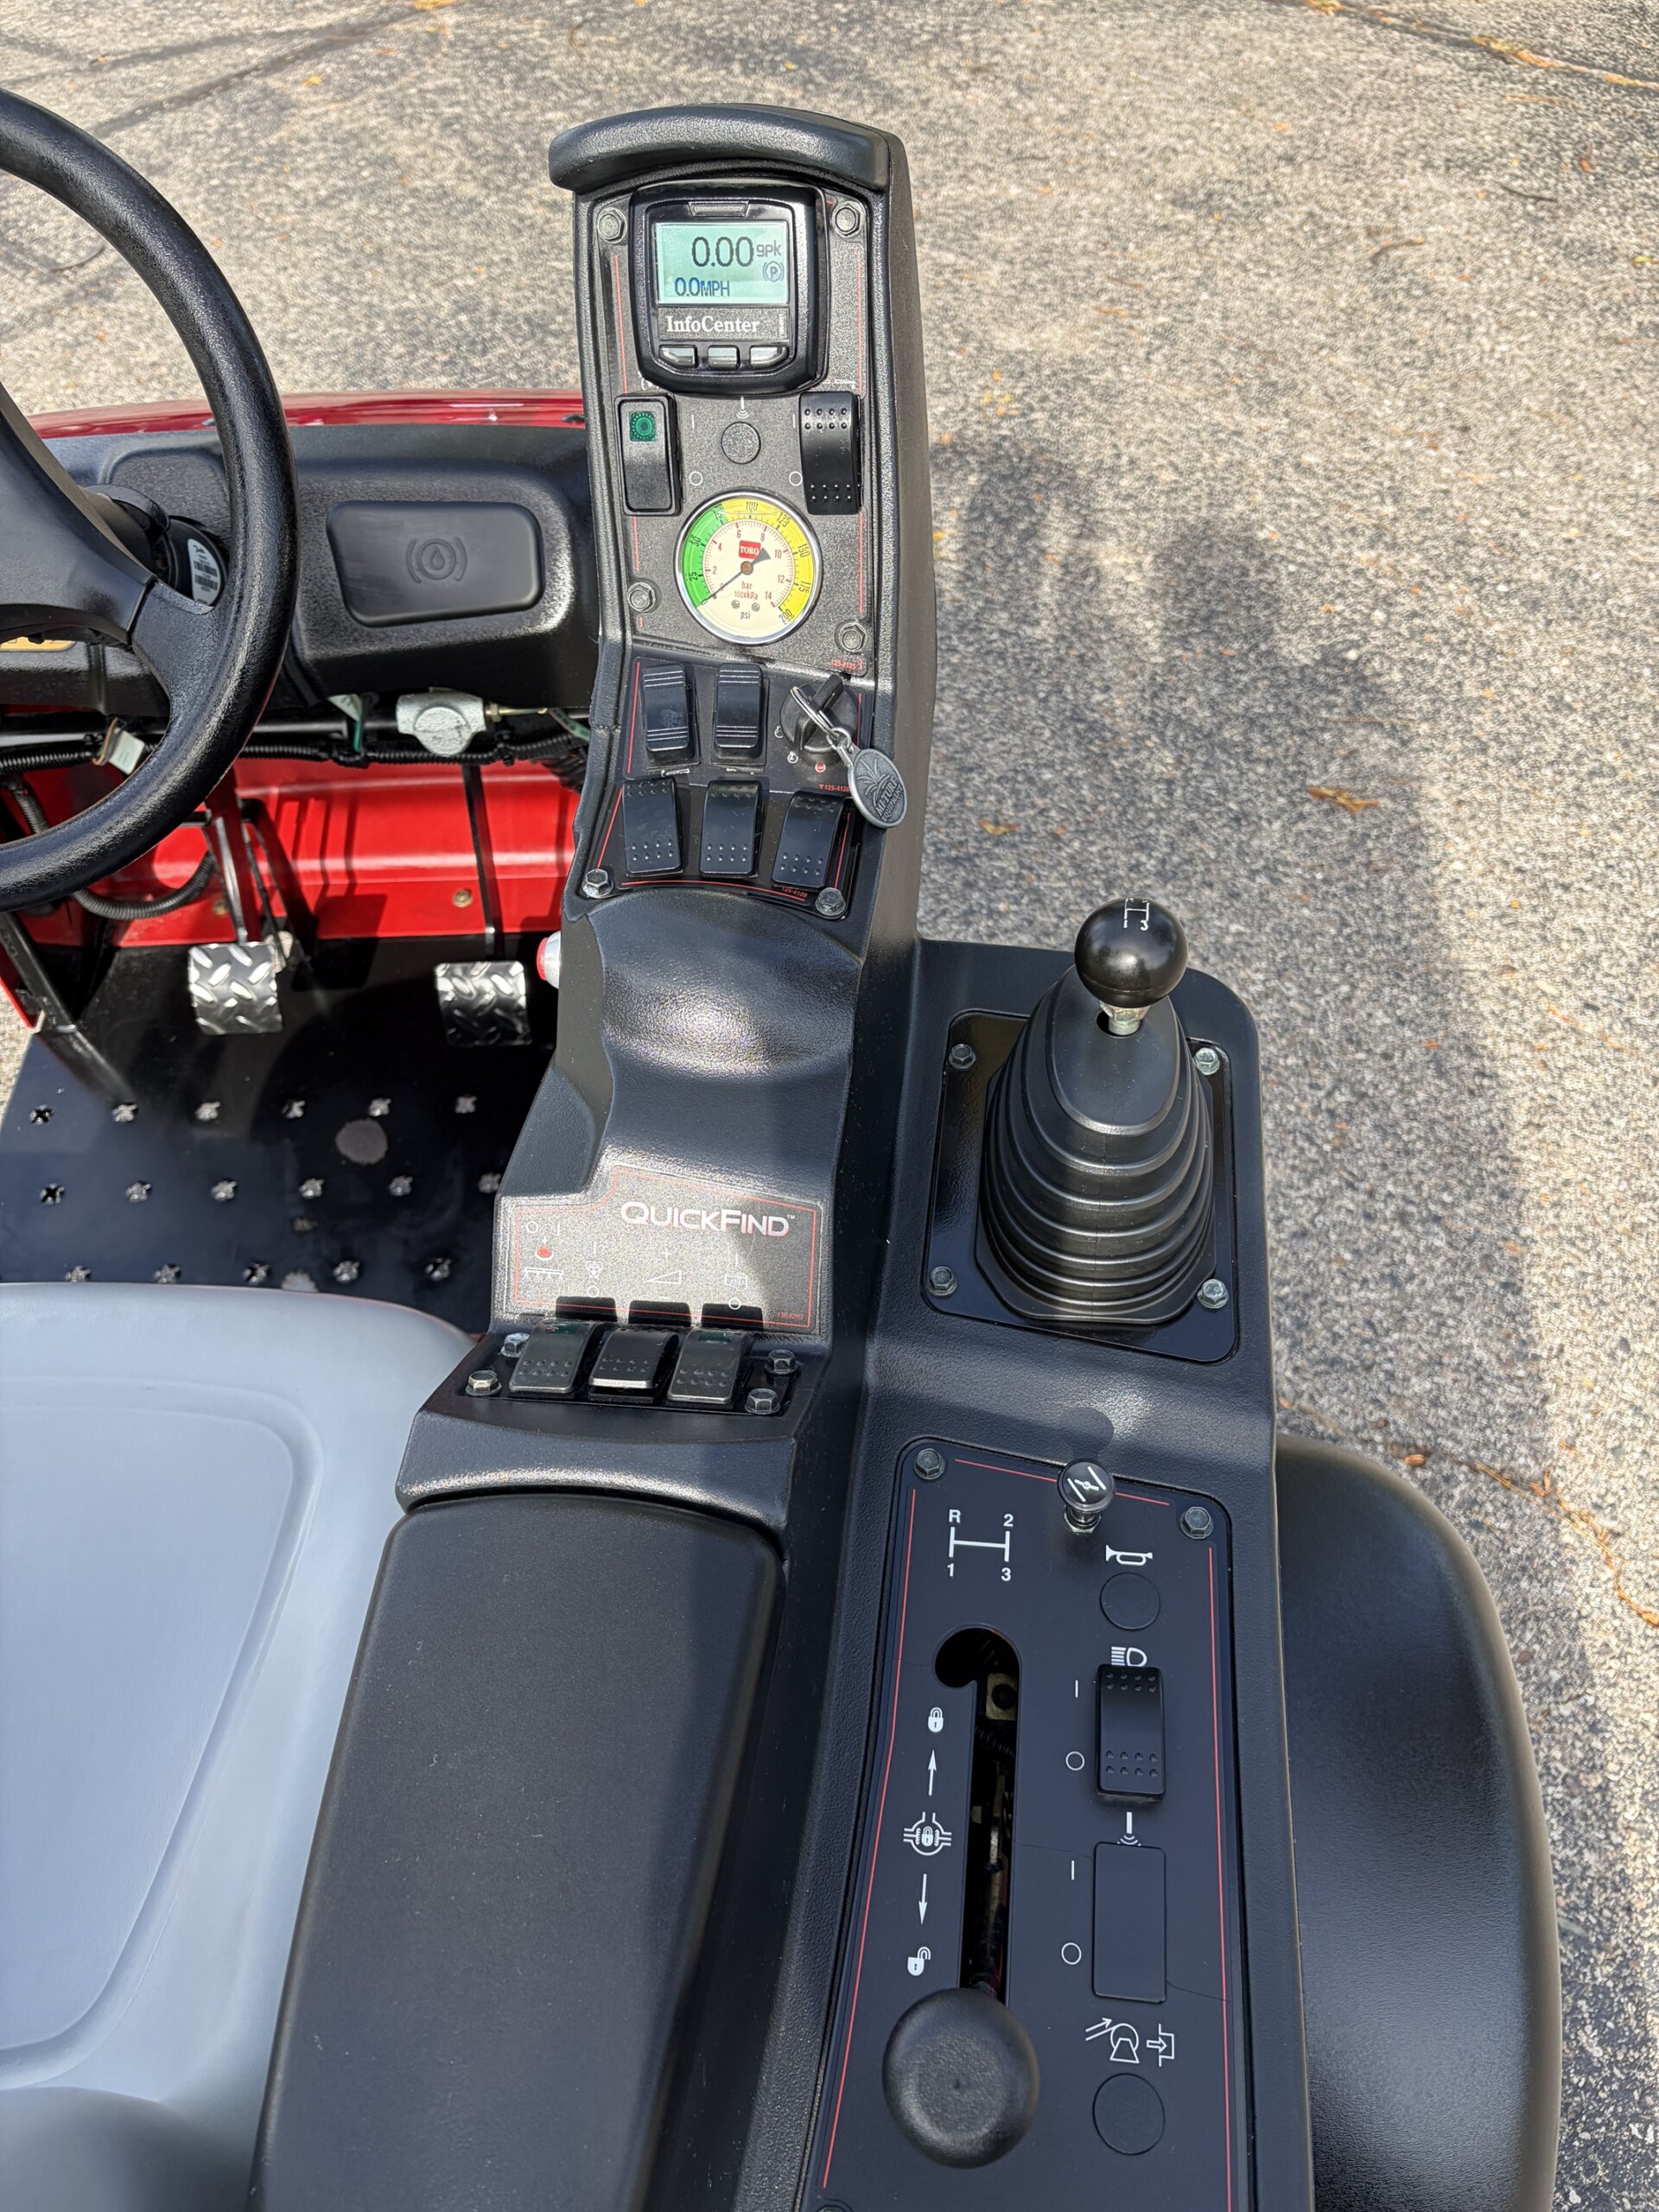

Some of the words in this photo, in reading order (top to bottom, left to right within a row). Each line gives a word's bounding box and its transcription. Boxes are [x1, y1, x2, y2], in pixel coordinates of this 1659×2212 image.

[691, 236, 753, 267] 0.00
[756, 240, 781, 257] gpk
[674, 277, 730, 296] 0.0MPH
[666, 315, 760, 333] InfoCenter
[746, 501, 759, 512] 100
[736, 530, 741, 538] 6
[760, 532, 766, 542] 8
[717, 543, 722, 551] 4
[740, 546, 760, 556] TORO
[798, 543, 810, 558] 150
[774, 549, 782, 558] 10
[712, 565, 717, 575] 2
[688, 571, 698, 582] 25
[778, 575, 785, 583] 12
[741, 581, 752, 589] bar
[765, 591, 772, 600] 14
[740, 611, 751, 620] psi
[779, 608, 791, 623] 200
[1141, 919, 1148, 931] 3
[620, 1201, 790, 1236] QUICKFIND
[949, 1509, 961, 1523] R
[1003, 1513, 1014, 1527] 2
[947, 1563, 954, 1577] 1
[1001, 1567, 1012, 1581] 3
